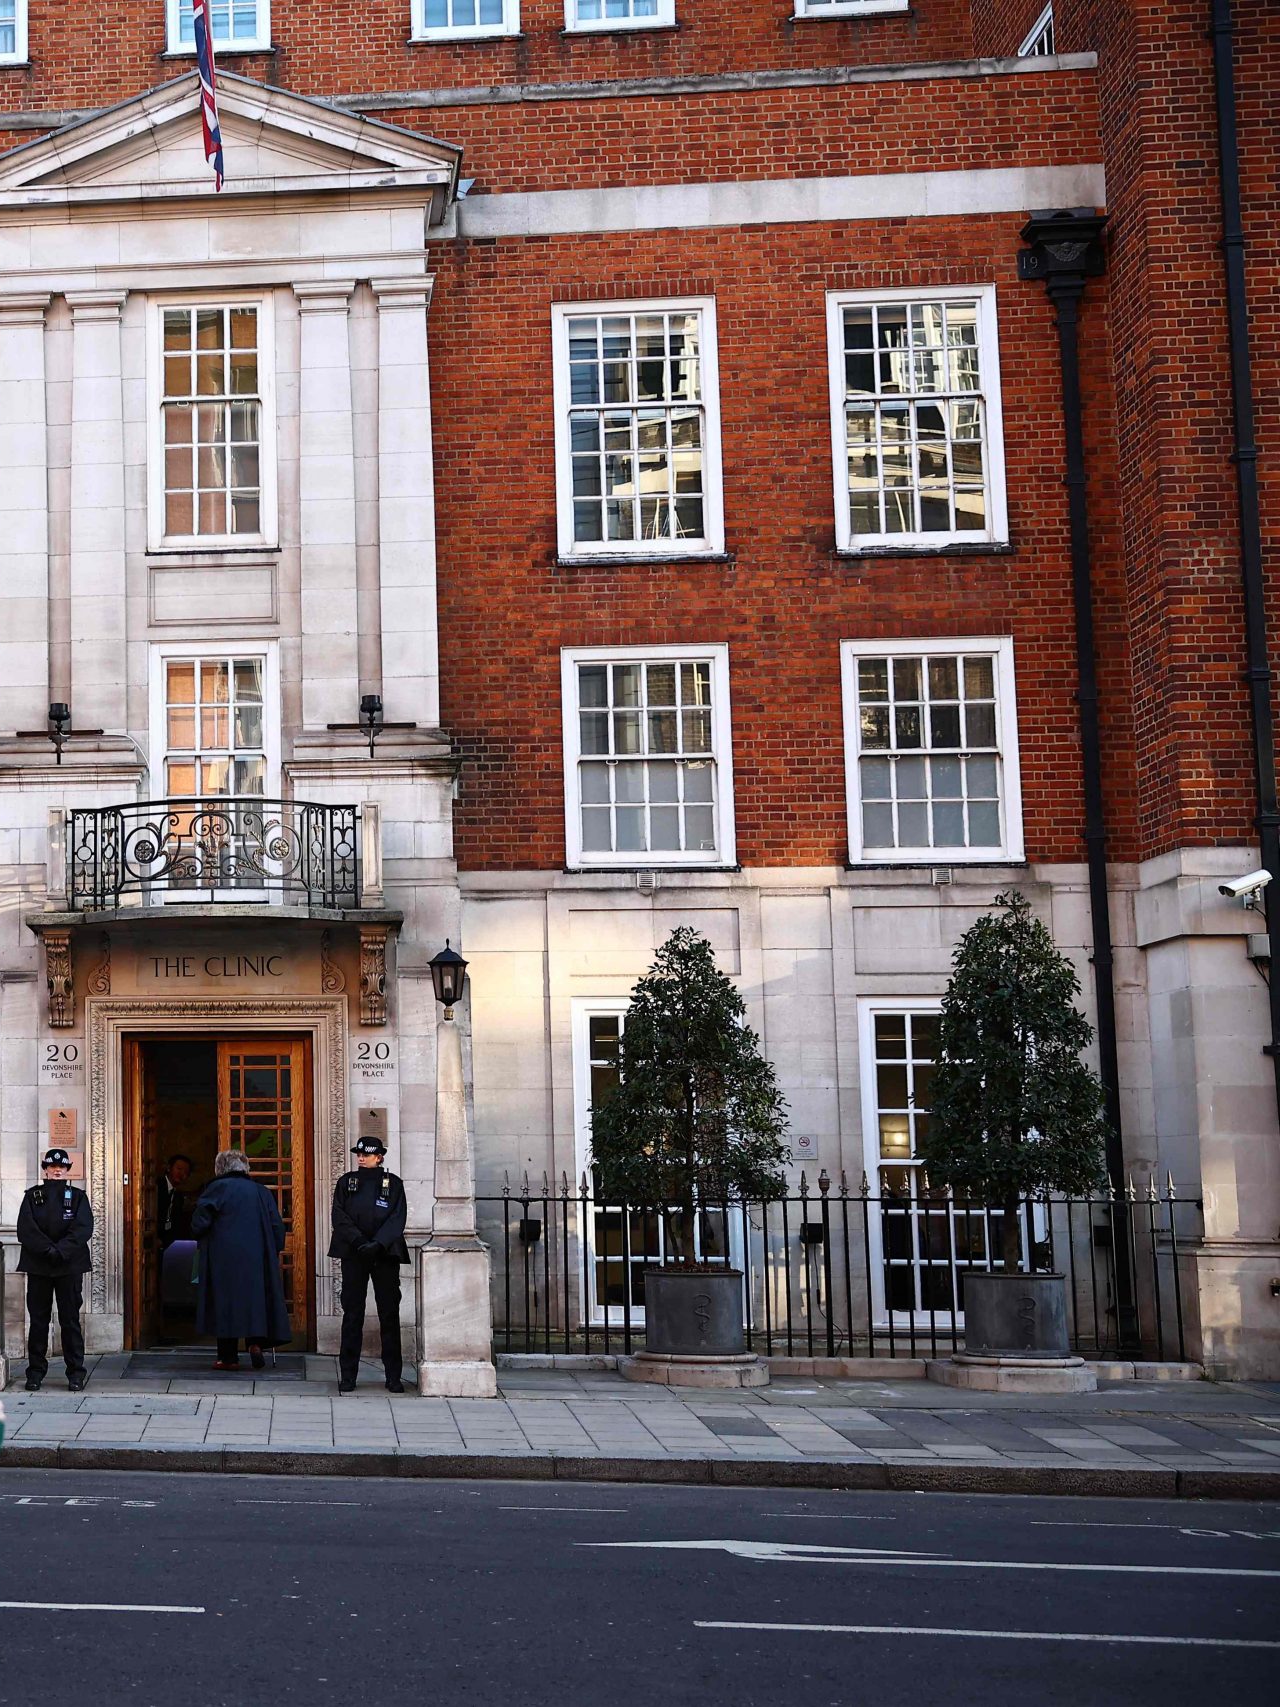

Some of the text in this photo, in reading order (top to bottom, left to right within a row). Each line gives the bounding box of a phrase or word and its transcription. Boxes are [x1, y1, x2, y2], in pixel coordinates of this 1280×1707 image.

[149, 955, 284, 977] THE CLINIC
[46, 1044, 79, 1062] 20
[357, 1042, 390, 1060] 20
[352, 1062, 395, 1070] DEVONSHIRE
[362, 1070, 385, 1078] PLACE
